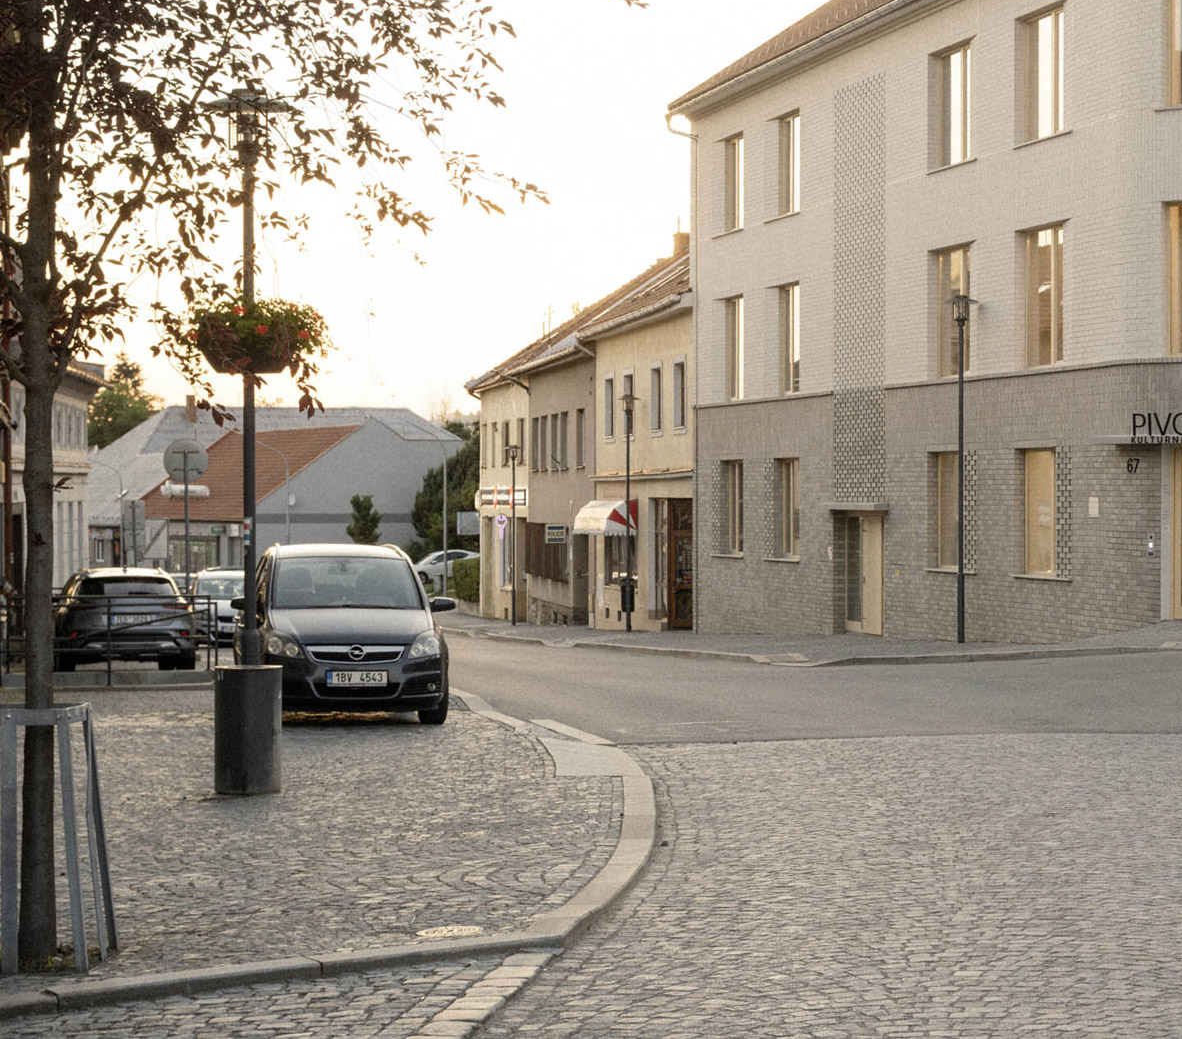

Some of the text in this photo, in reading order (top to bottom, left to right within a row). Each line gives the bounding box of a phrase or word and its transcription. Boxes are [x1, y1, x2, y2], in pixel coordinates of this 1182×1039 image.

[1126, 458, 1140, 474] 67
[335, 672, 384, 683] 1BV 4543
